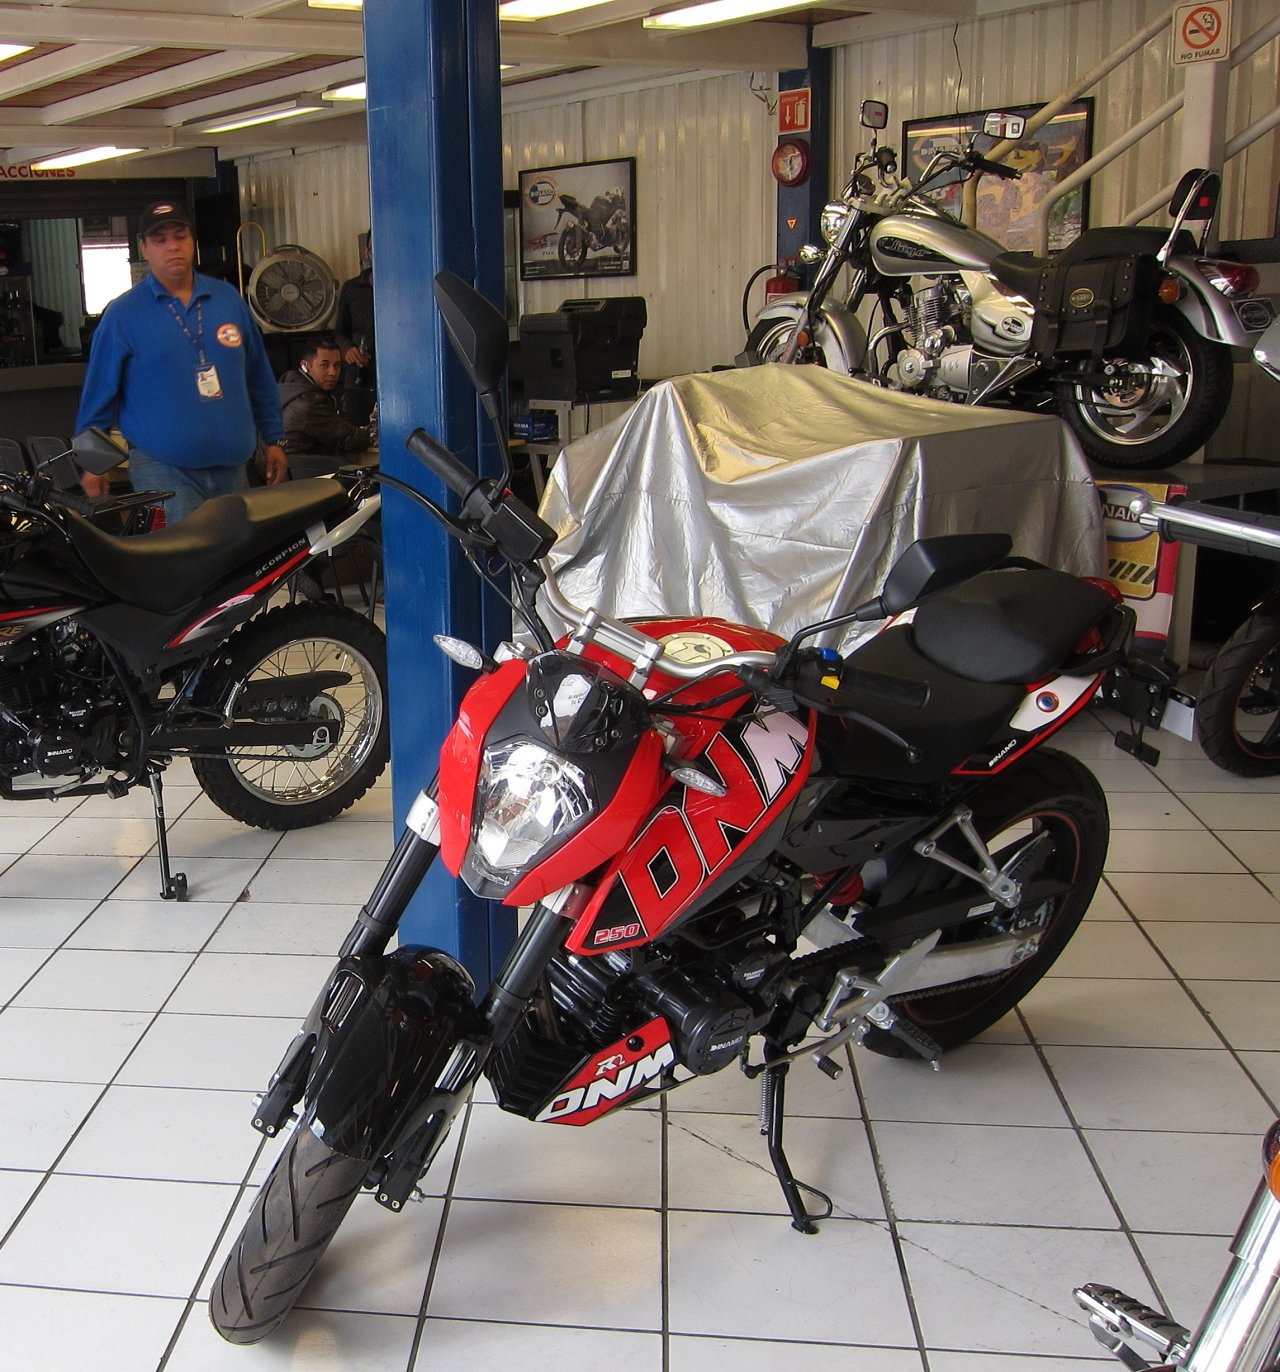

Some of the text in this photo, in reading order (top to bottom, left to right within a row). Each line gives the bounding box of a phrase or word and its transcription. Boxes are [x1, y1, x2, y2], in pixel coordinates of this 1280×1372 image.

[255, 537, 306, 577] SCORPION
[988, 738, 1017, 768] DINAMO
[617, 704, 810, 939] DNM
[594, 922, 640, 945] 250
[709, 1036, 743, 1051] DINAMO
[535, 1042, 676, 1121] DNM
